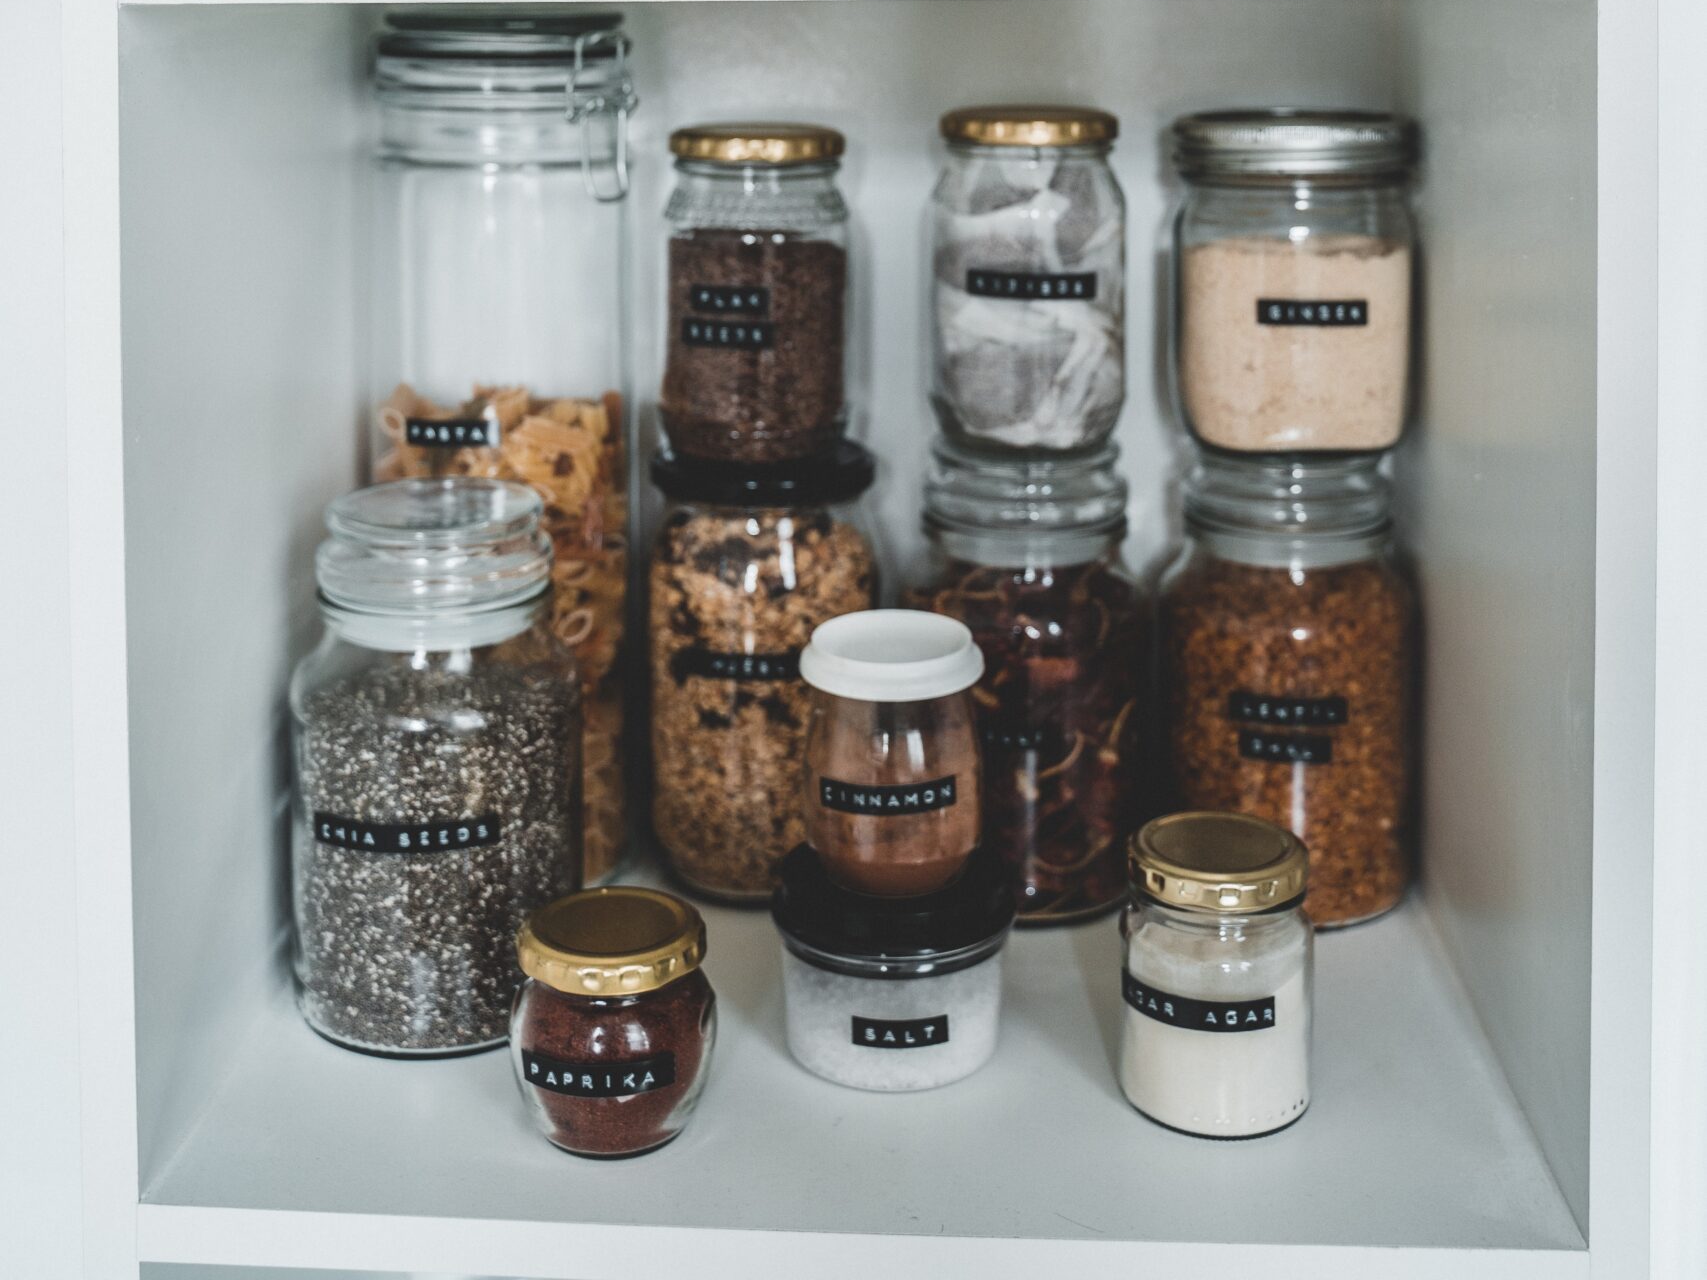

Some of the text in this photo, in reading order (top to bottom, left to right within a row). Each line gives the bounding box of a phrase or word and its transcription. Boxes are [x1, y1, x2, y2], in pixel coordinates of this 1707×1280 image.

[825, 784, 952, 807] CINNAMON
[321, 823, 488, 848] CHIA SEEDS
[1205, 1008, 1273, 1025] AGAR
[864, 1025, 935, 1044] SALT
[530, 1061, 655, 1089] PAPRIKA
